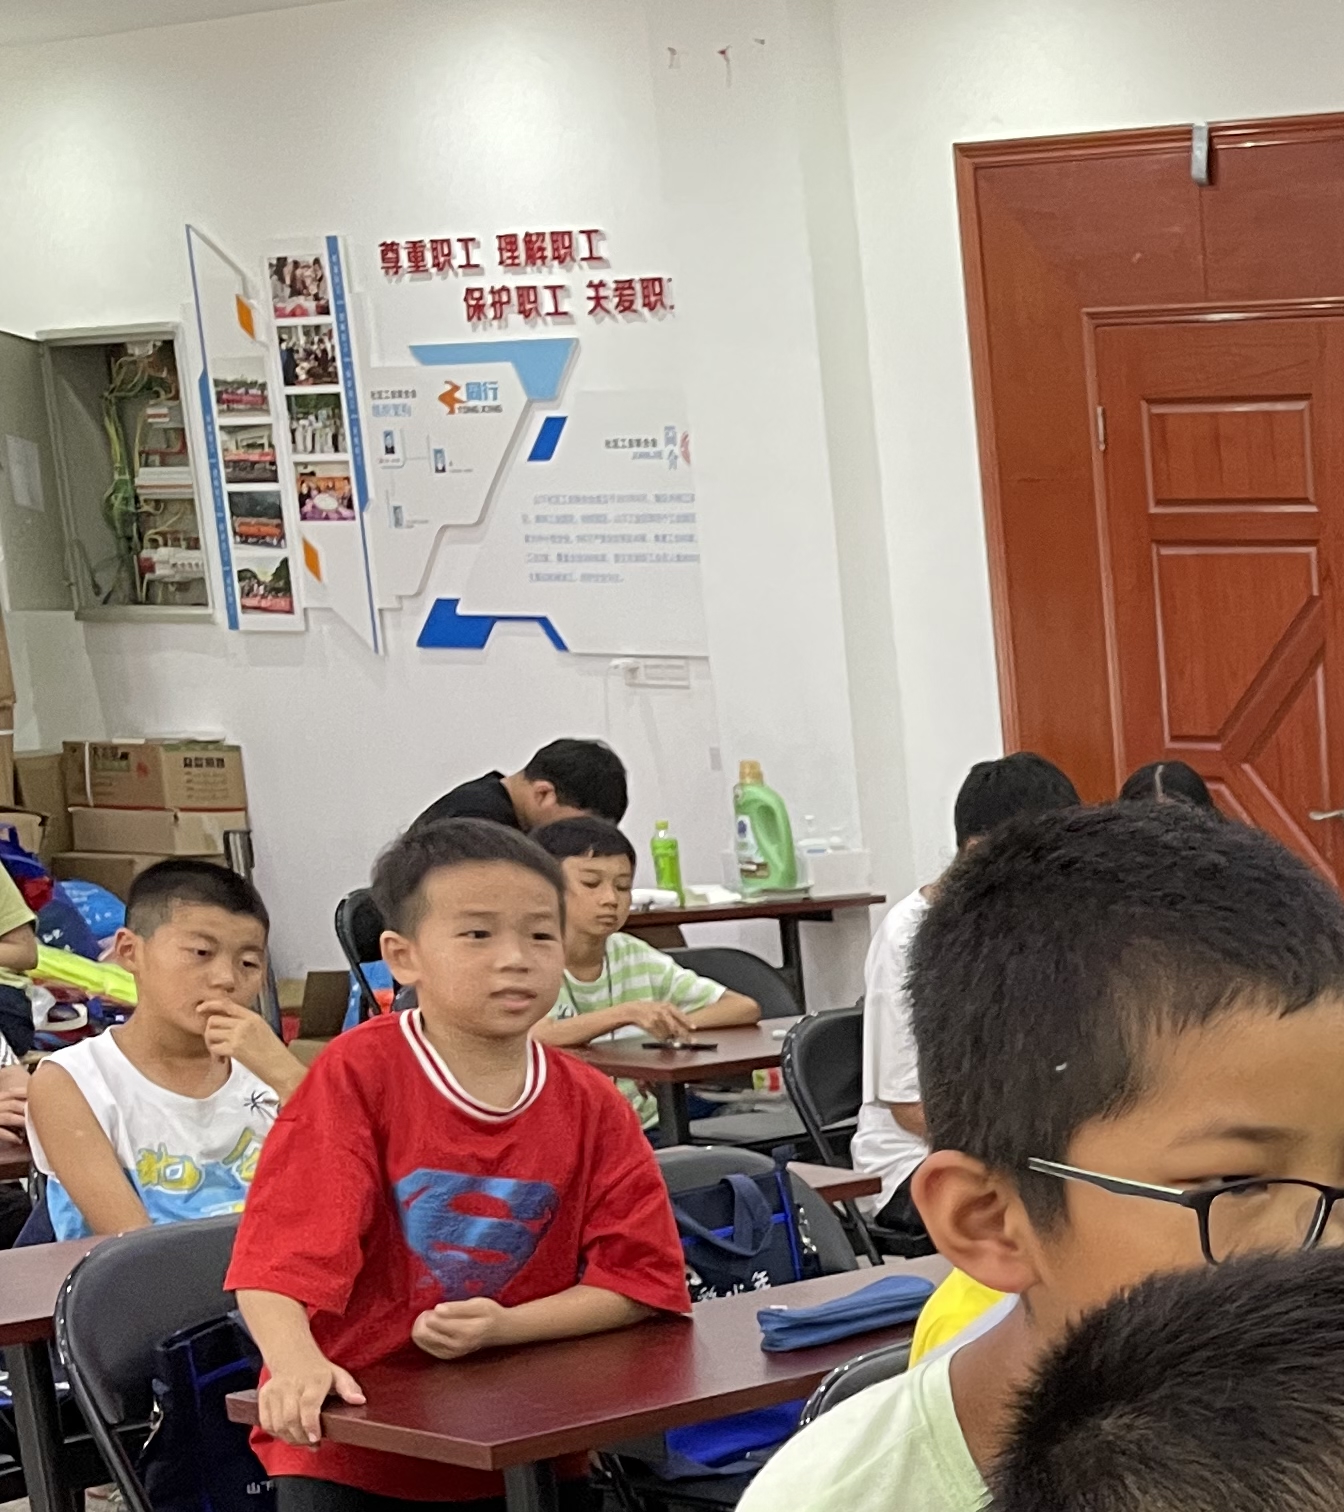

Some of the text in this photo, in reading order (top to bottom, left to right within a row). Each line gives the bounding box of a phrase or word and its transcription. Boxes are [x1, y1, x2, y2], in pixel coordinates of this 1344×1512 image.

[379, 229, 603, 275] 尊重职工 理解职工
[464, 277, 675, 321] 保护职工 关爱职
[466, 381, 499, 401] 同行
